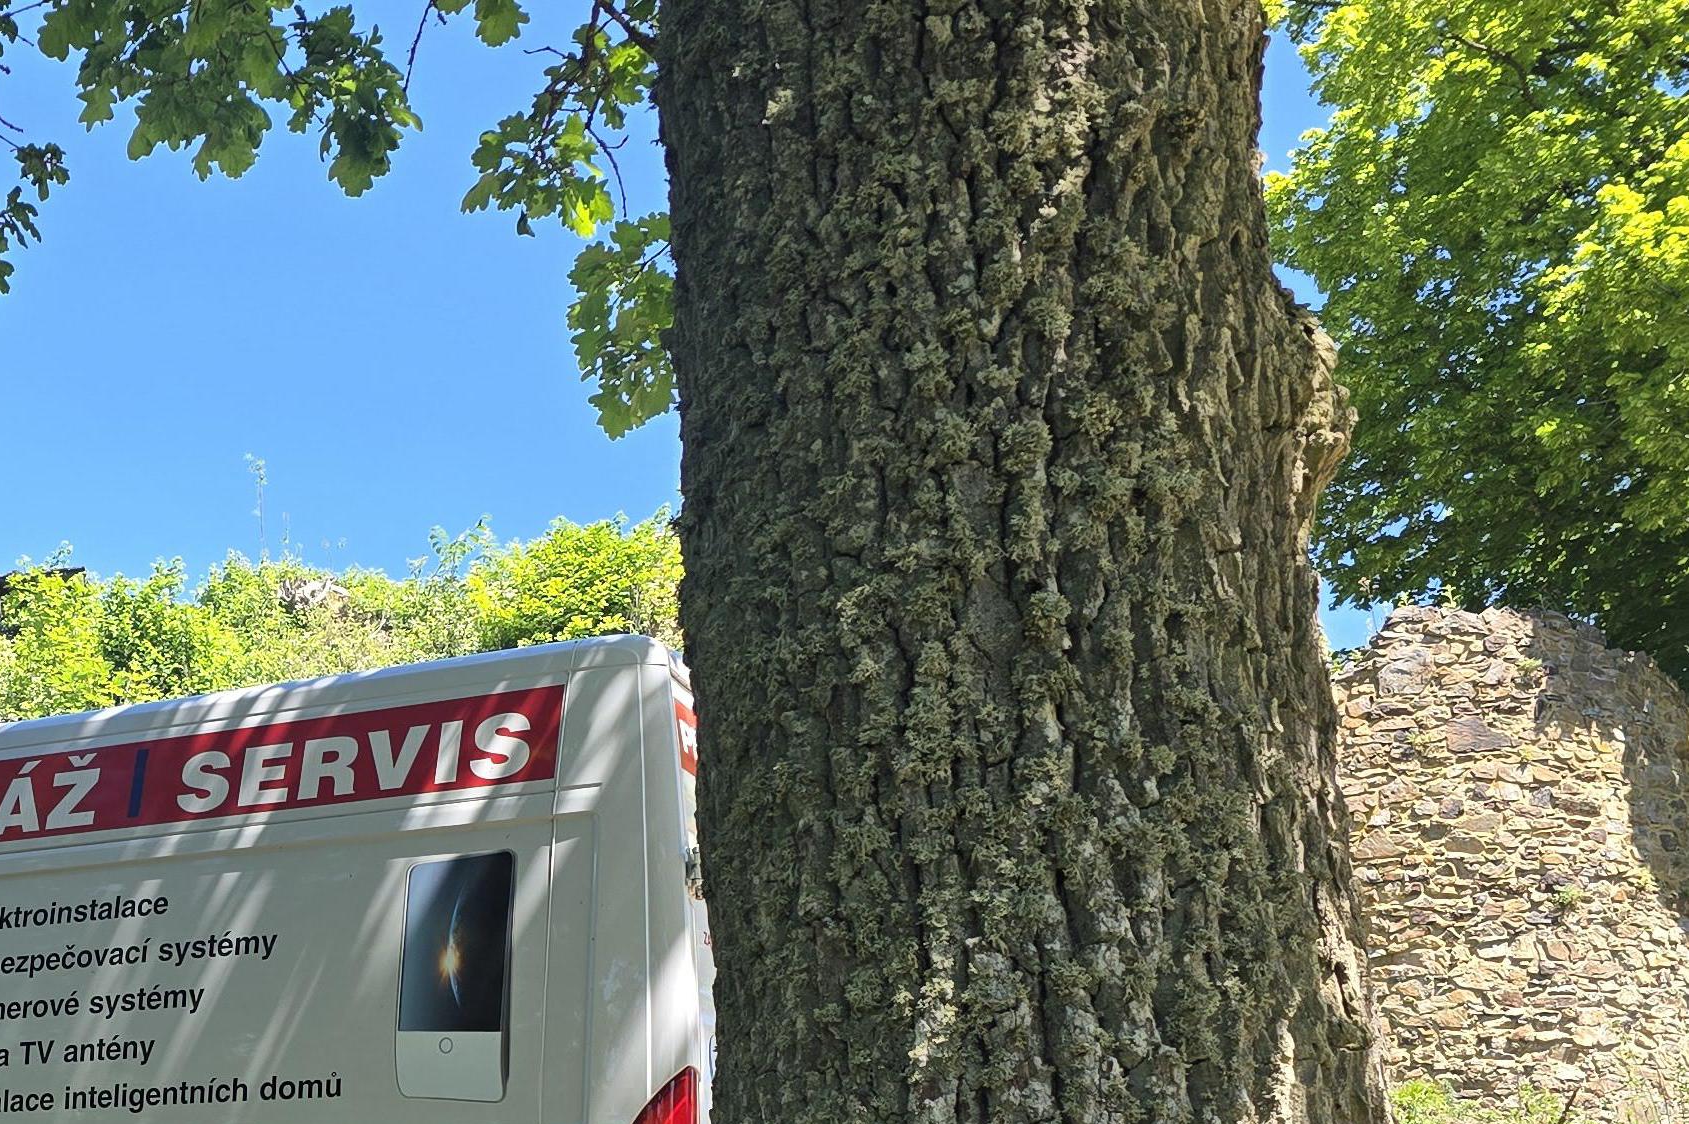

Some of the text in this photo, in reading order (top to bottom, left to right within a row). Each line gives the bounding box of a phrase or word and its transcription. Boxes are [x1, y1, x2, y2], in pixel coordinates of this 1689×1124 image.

[176, 712, 532, 815] SERVIS
[158, 931, 277, 965] systémy
[89, 984, 204, 1019] systémy
[20, 1040, 54, 1064] TV
[64, 1035, 155, 1065] antény
[65, 1078, 247, 1113] inteligentních
[260, 1072, 341, 1100] domů
